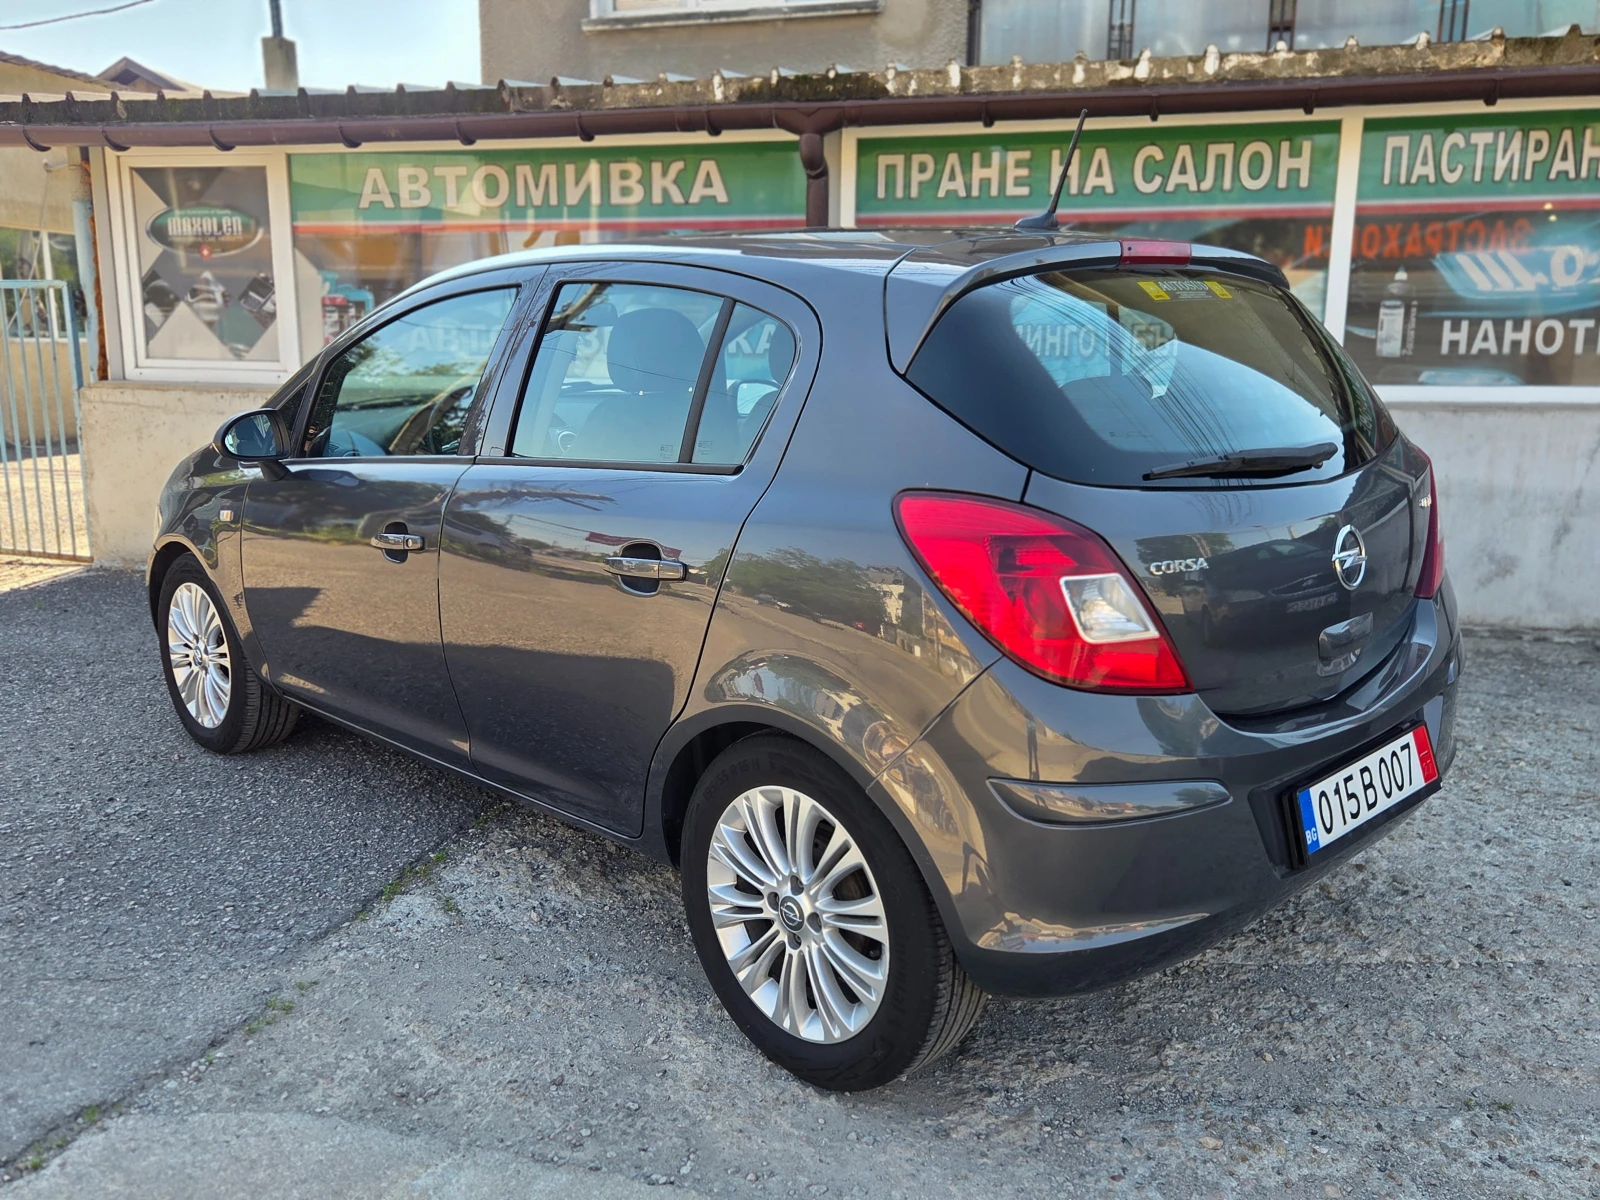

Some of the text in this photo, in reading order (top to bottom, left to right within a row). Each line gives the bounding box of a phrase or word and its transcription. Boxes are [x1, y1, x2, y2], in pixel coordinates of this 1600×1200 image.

[876, 139, 1314, 199] ПРАНЕ НА САЛОН
[1383, 127, 1600, 185] ПАСТИРАН
[358, 159, 730, 210] АВТОМИВКА
[1440, 318, 1600, 356] НАНОТ
[1150, 557, 1209, 575] CORSA
[1305, 827, 1317, 844] BG
